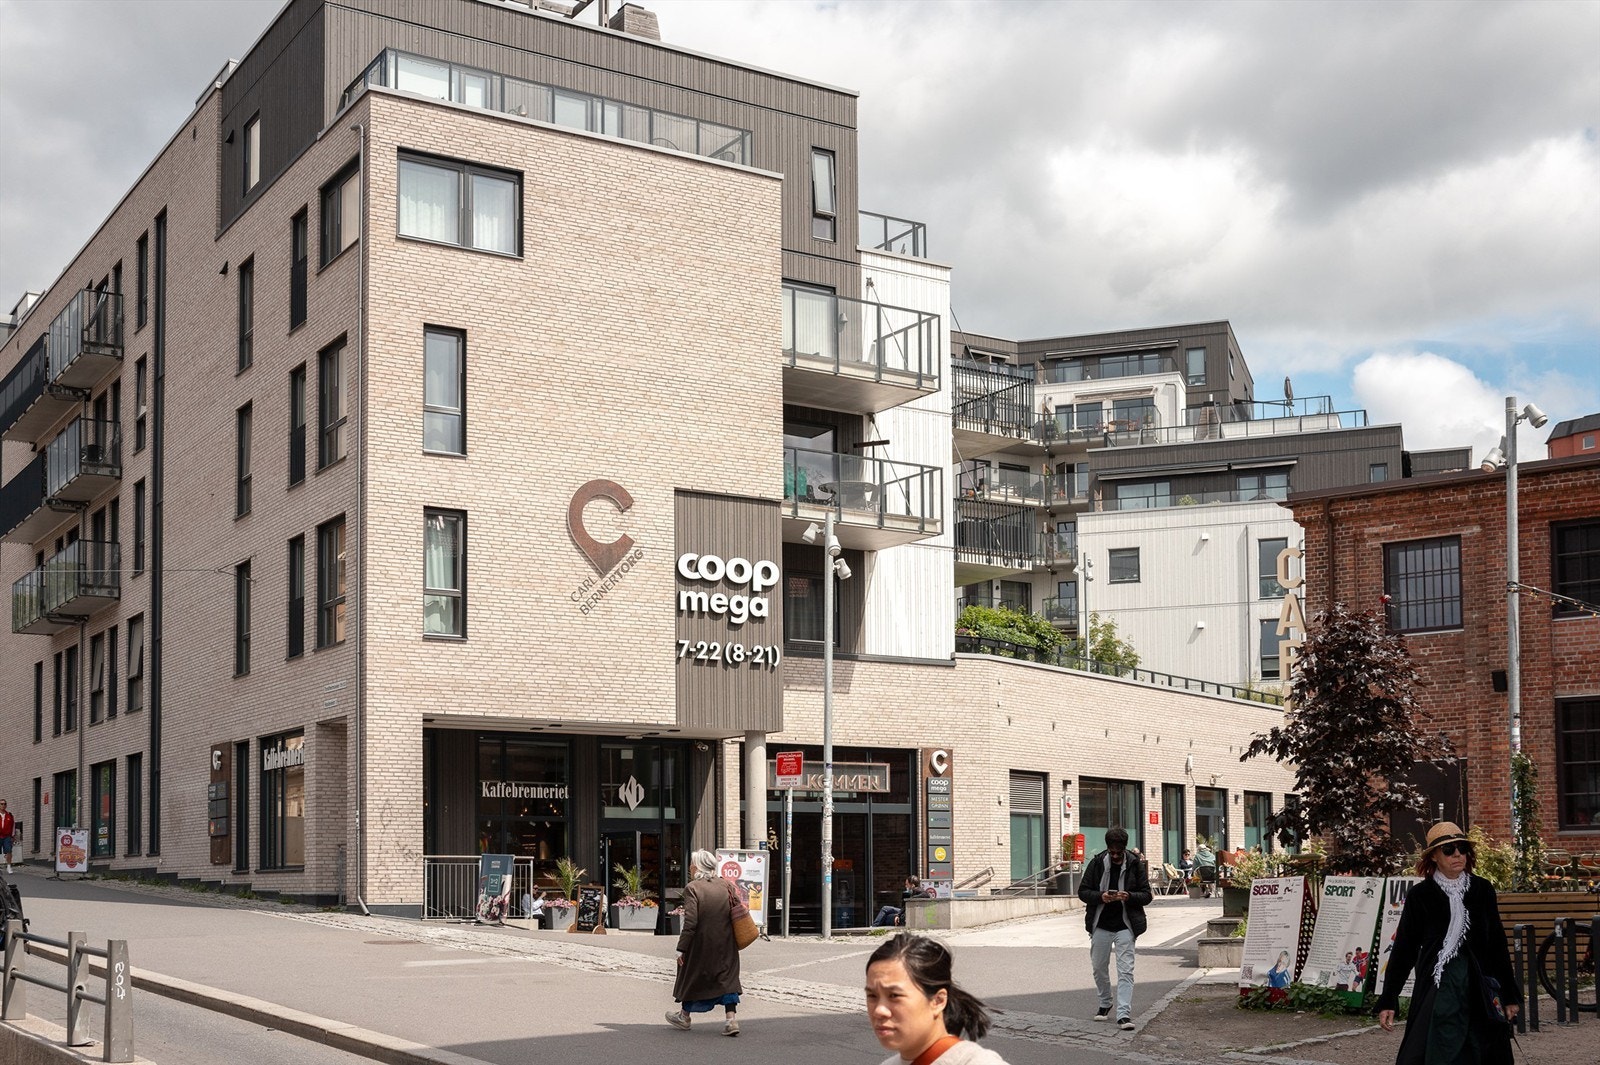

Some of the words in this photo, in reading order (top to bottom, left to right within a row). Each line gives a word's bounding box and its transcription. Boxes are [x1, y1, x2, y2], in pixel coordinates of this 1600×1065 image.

[678, 553, 780, 592] coop
[570, 576, 598, 603] CARL
[679, 589, 769, 624] mega
[678, 640, 721, 661] 7-22
[725, 641, 781, 667] (8-21)
[481, 781, 570, 799] Kaffebrenneriet
[931, 779, 949, 787] coop
[723, 868, 739, 878] 100
[1252, 884, 1279, 896] SCENE
[1324, 884, 1356, 897] SPORT
